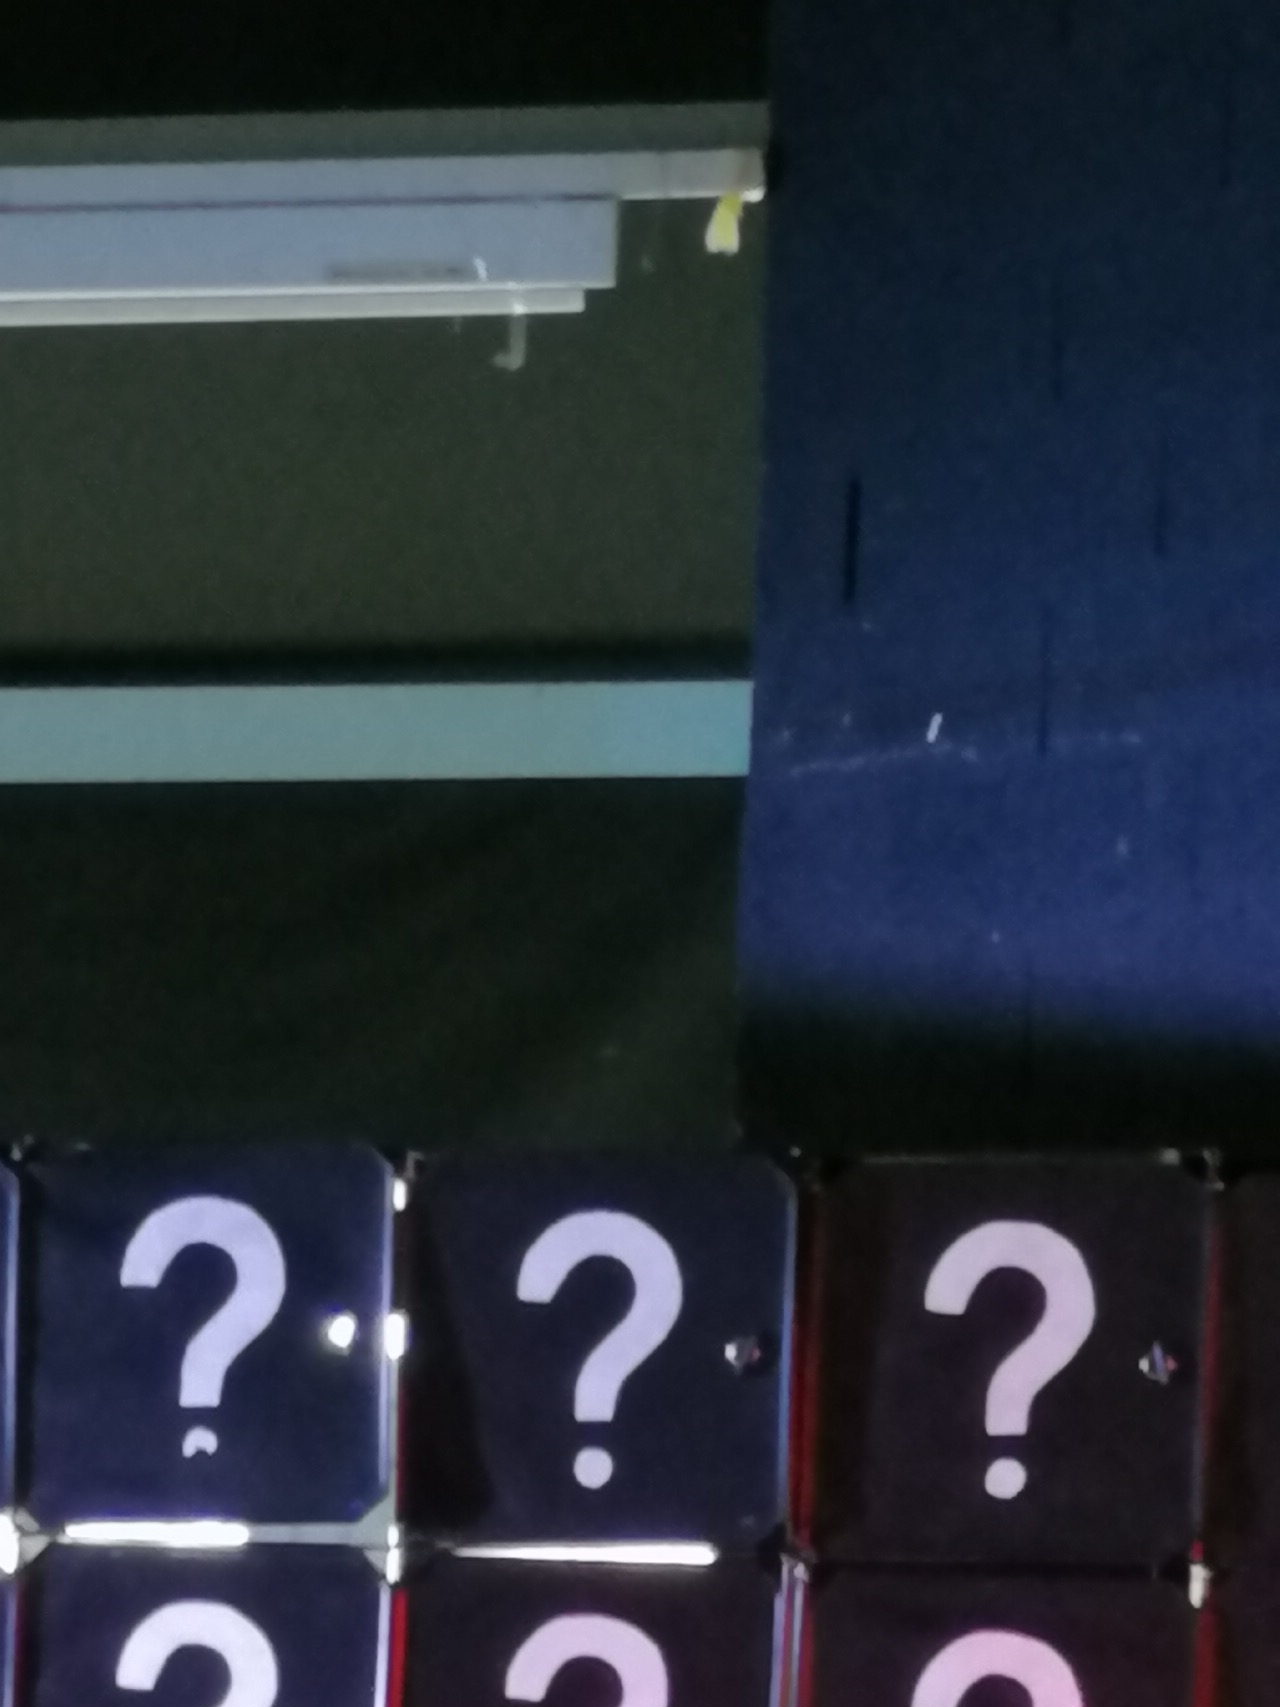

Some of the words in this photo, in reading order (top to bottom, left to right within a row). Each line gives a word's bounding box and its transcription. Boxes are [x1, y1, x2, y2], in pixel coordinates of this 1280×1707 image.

[120, 1196, 286, 1457] ?
[517, 1210, 683, 1489] ?
[924, 1220, 1096, 1499] ?
